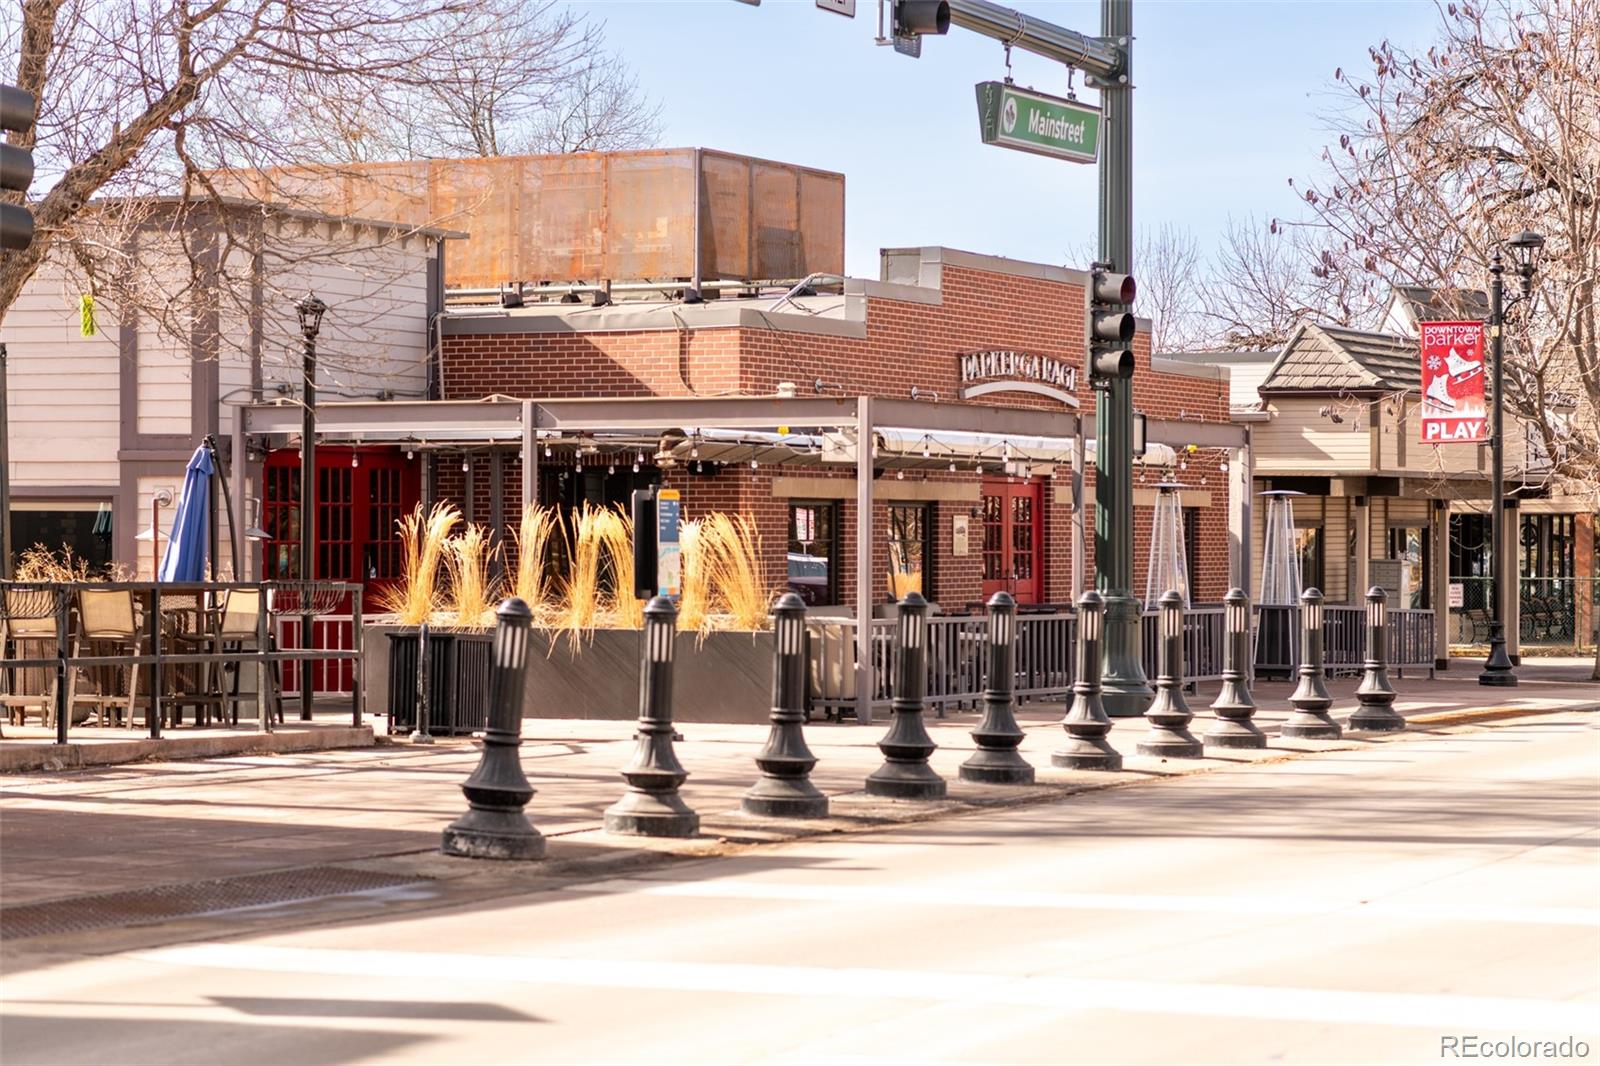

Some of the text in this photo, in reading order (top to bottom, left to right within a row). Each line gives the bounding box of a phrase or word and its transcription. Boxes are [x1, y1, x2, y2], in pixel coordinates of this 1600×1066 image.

[1028, 108, 1085, 144] Mainstreet
[1424, 325, 1481, 334] DOWNTOWN
[1424, 333, 1480, 349] parker
[1427, 422, 1481, 440] PLAY
